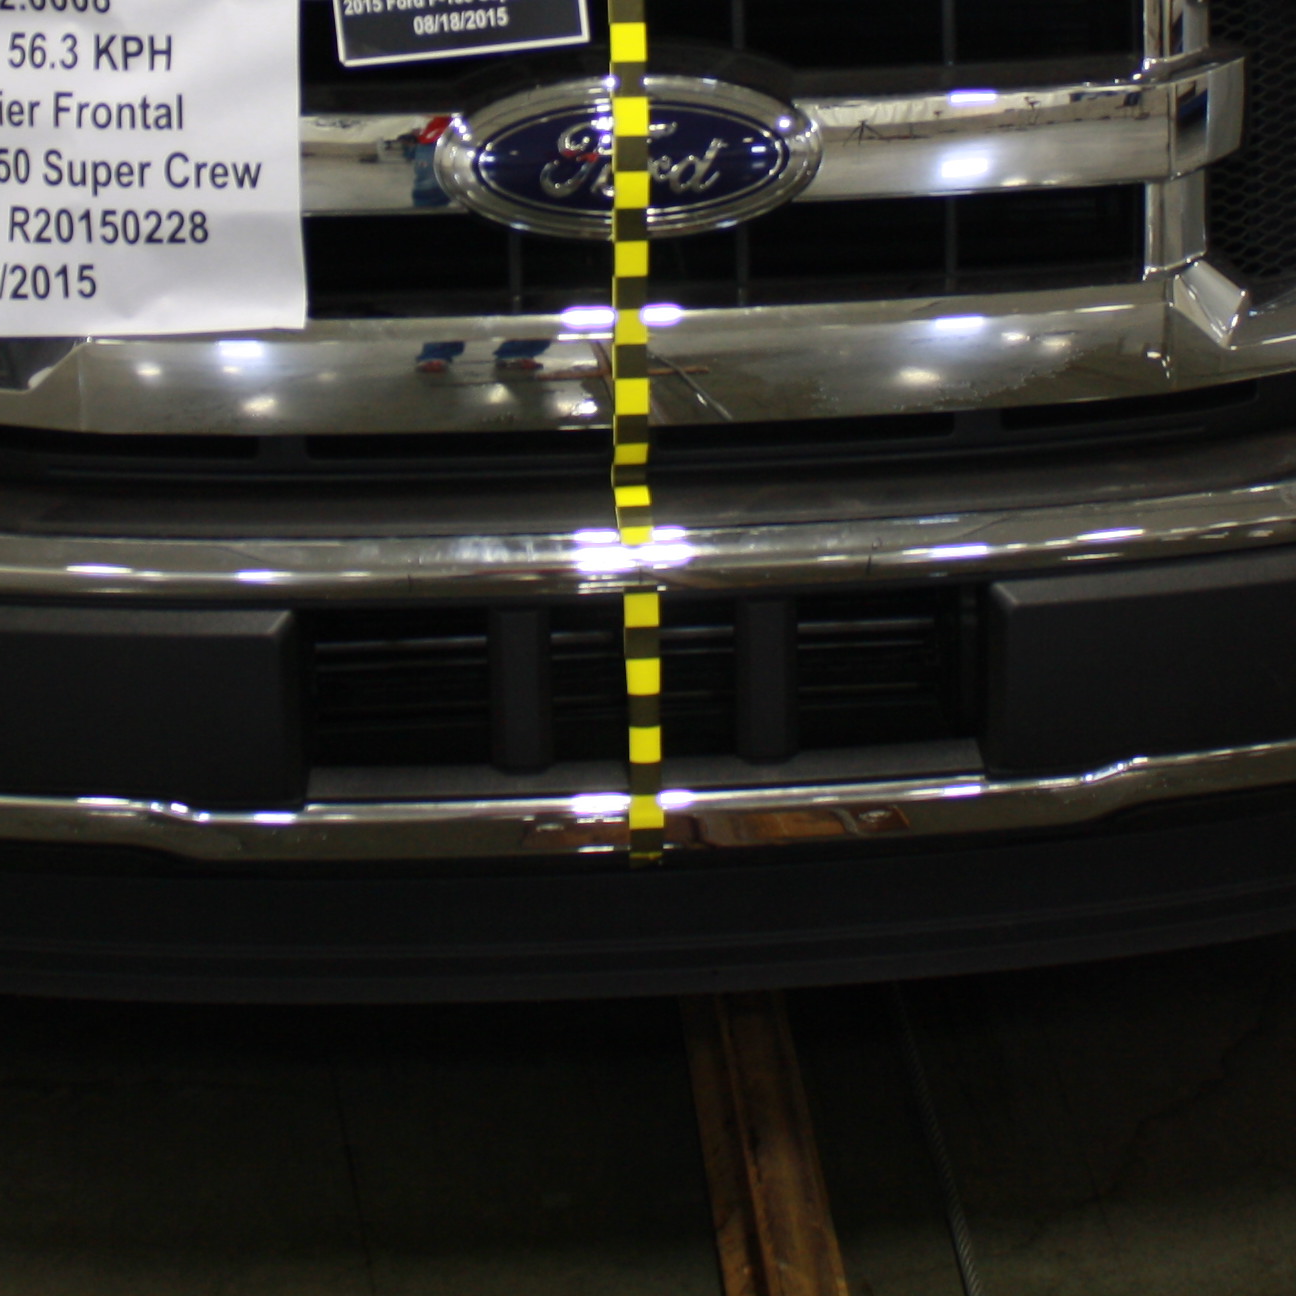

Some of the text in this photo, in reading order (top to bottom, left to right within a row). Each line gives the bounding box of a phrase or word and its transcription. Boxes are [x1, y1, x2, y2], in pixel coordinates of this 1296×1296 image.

[412, 6, 509, 35] 08/18/2015
[8, 33, 79, 70] 56.3
[94, 34, 172, 72] KPH
[53, 92, 184, 131] Frontal
[43, 149, 152, 197] Super
[164, 152, 262, 189] Crew
[9, 206, 209, 245] R20150228
